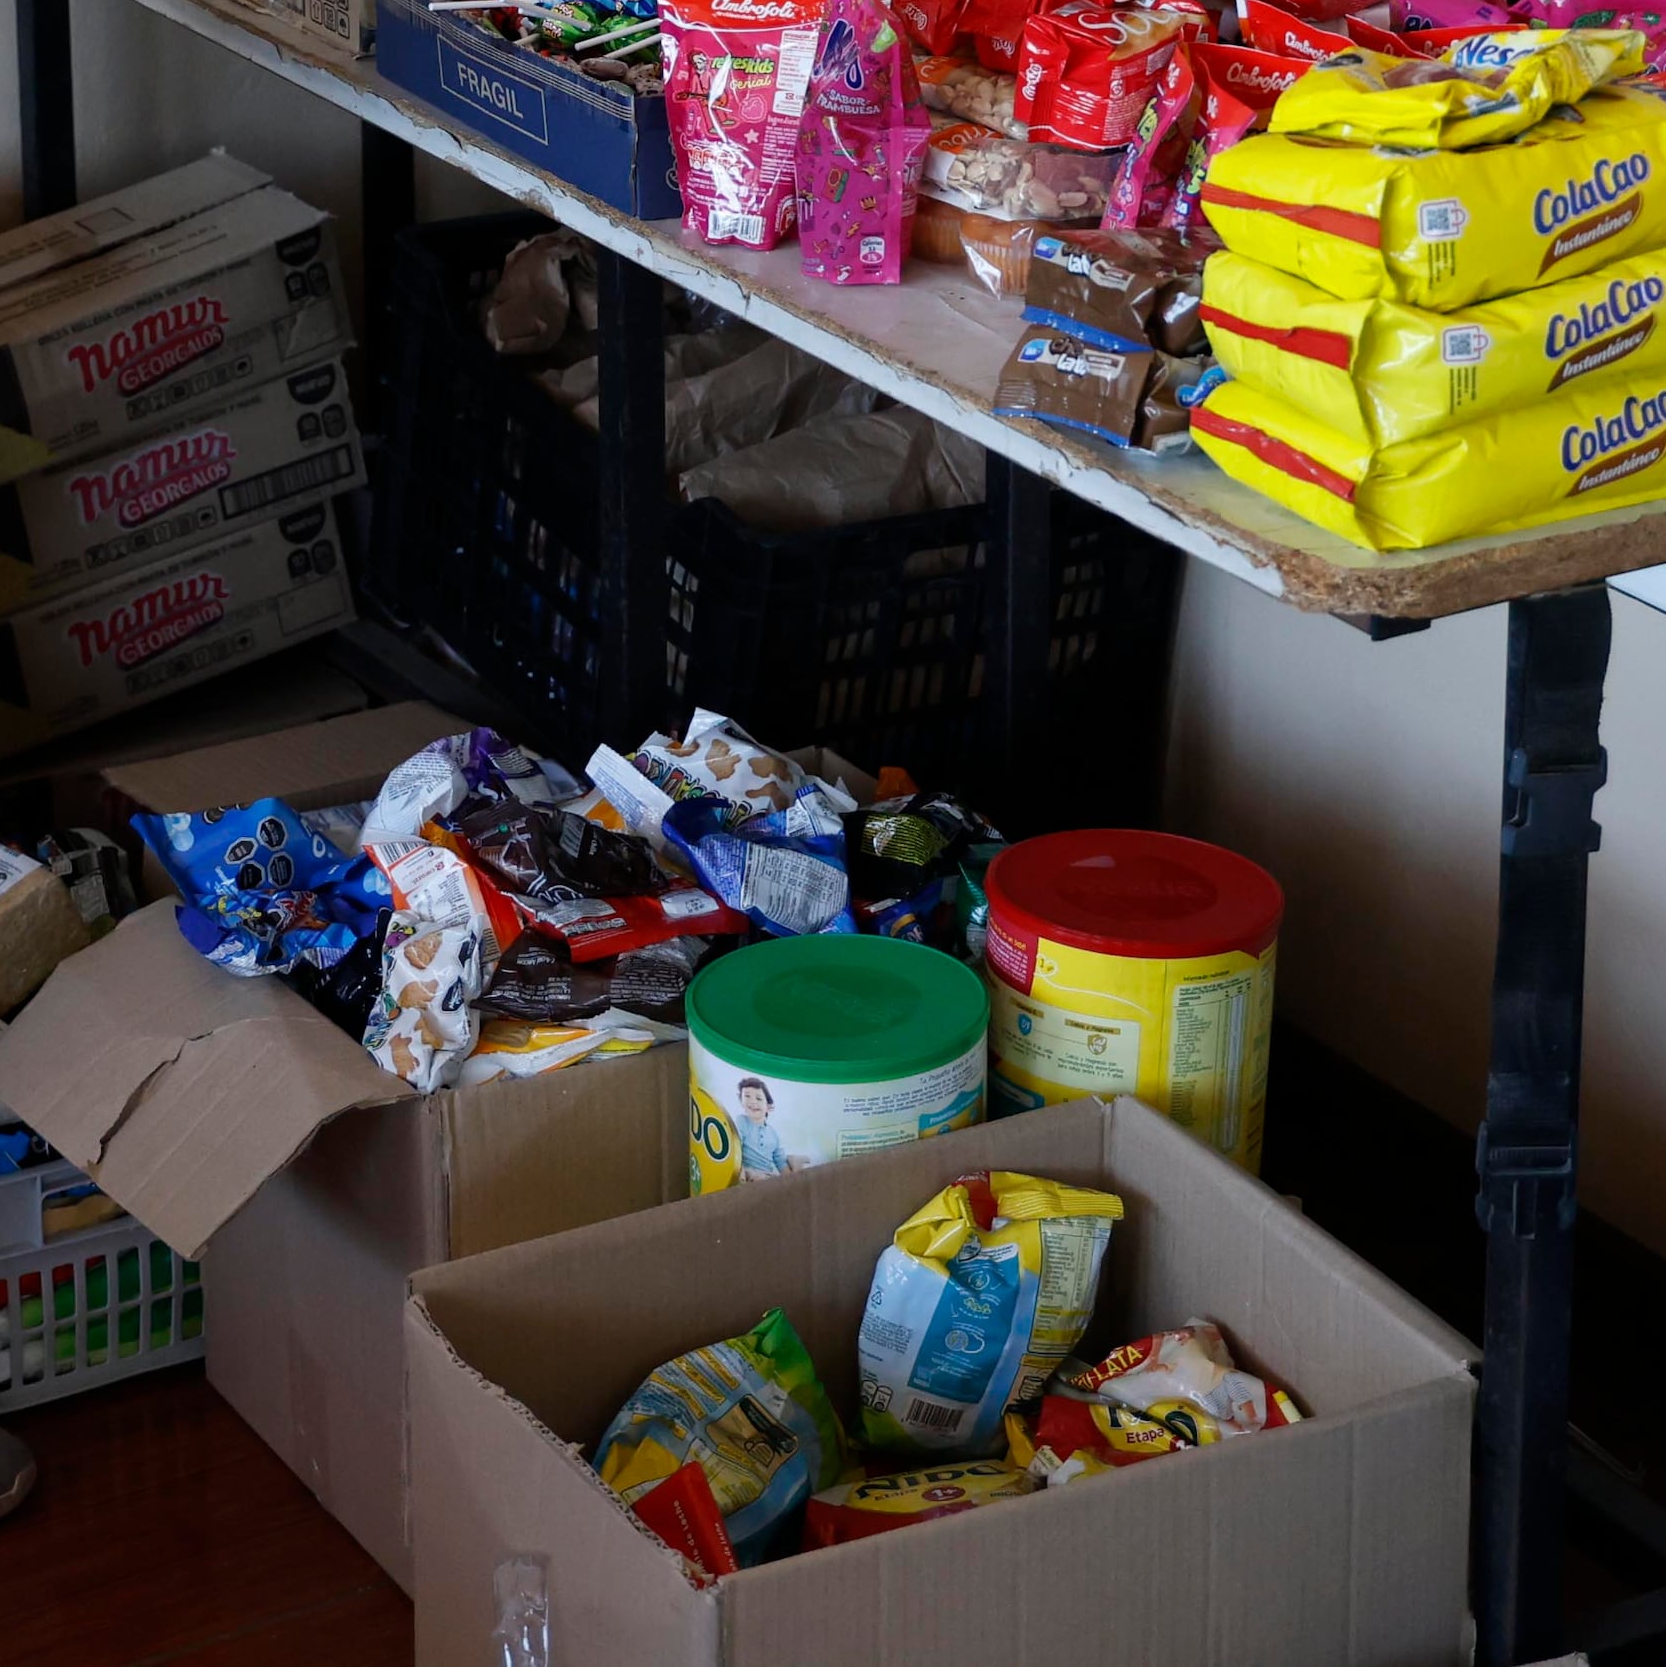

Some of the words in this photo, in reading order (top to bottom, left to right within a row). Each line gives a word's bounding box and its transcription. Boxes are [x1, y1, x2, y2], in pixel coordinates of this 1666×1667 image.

[456, 60, 525, 120] FRAGIL
[730, 76, 771, 91] Genial
[816, 95, 881, 115] FRAMBUESA
[828, 90, 863, 106] SABOR
[1533, 150, 1651, 236] ColaCao
[1552, 207, 1635, 258] Instantáneo
[67, 295, 230, 392] namur
[1543, 273, 1666, 360] ColaCao
[116, 326, 224, 395] GEORGALOS
[1563, 331, 1646, 381] Instantáneo
[69, 432, 237, 524] namur
[119, 459, 230, 528] GEORGALOS
[1579, 449, 1662, 492] Instantáneo
[67, 572, 230, 668] namur
[117, 600, 224, 669] GEORGALOS
[1125, 1427, 1166, 1444] Etapa
